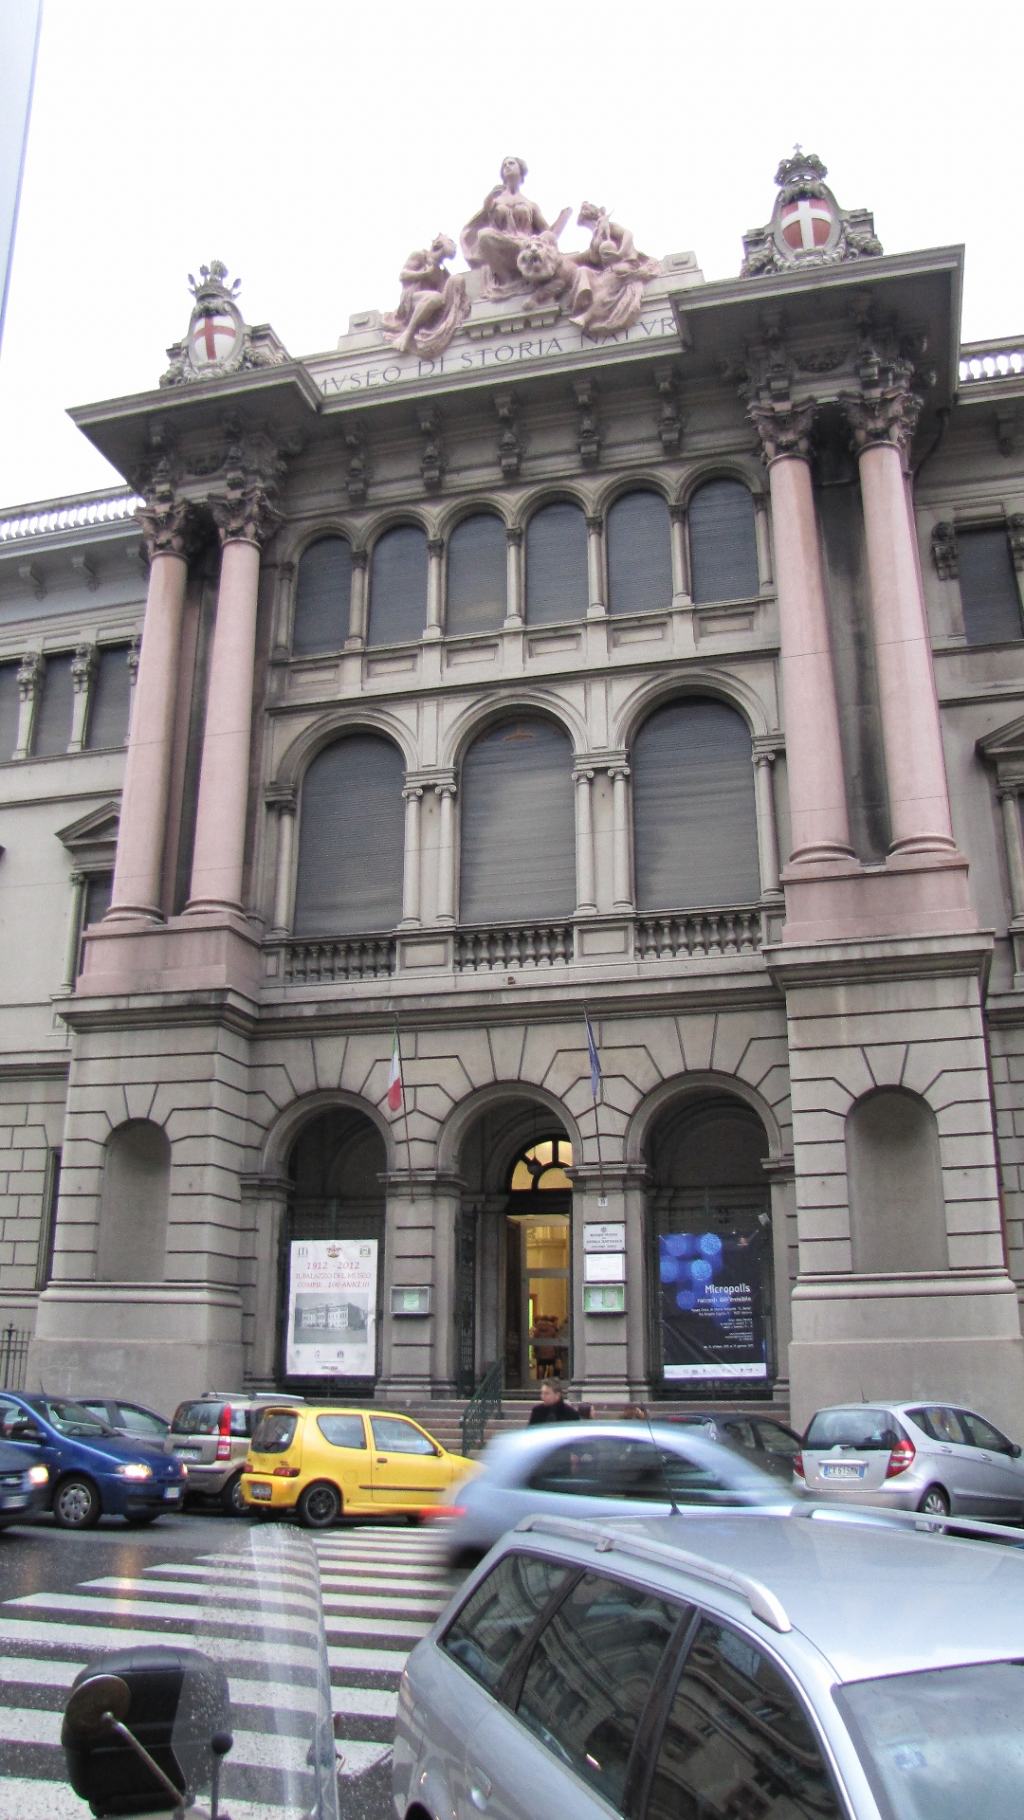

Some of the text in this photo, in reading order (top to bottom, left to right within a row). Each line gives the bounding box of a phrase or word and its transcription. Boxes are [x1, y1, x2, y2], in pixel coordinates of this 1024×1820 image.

[418, 357, 444, 377] DI
[461, 338, 562, 369] STORIA
[336, 1261, 360, 1270] 2012
[705, 1283, 751, 1295] Micropolis
